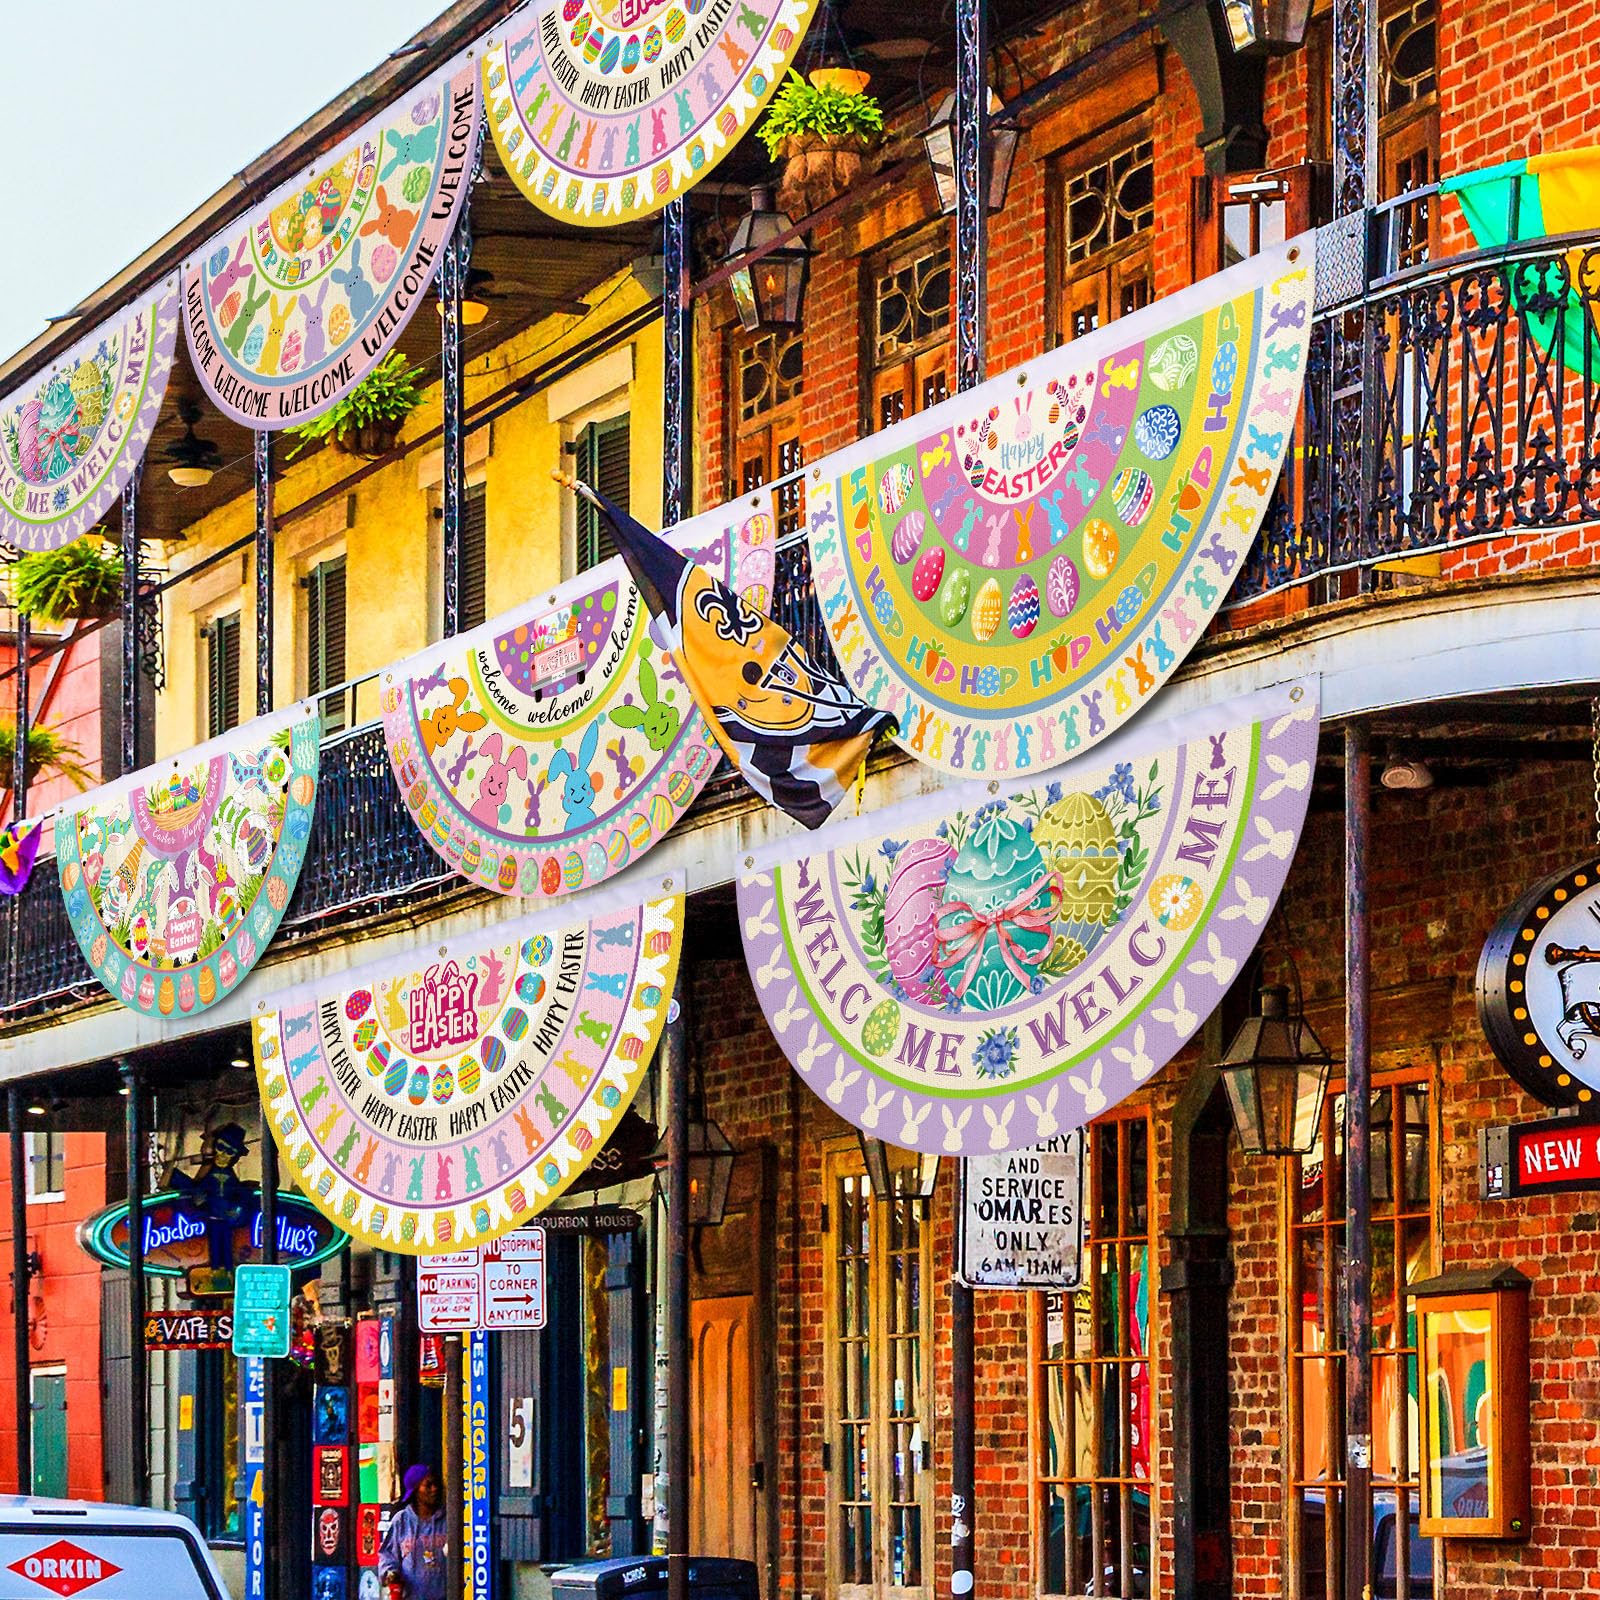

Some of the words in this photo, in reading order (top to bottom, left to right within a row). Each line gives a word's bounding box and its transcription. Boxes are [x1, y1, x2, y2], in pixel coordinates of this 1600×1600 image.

[541, 10, 554, 57] HAPPY
[551, 51, 580, 95] EASTER
[580, 79, 612, 110] HAPPY
[613, 76, 651, 110] EASTER
[660, 39, 696, 90] HAPPY
[186, 278, 217, 372] WELCOME
[214, 363, 272, 418] WELCOME
[279, 353, 356, 418] WELCOME
[361, 237, 437, 357] WELCOME
[432, 82, 475, 221] WELCOME
[1000, 431, 1045, 475] Happy
[981, 439, 1068, 498] EASTER
[477, 649, 519, 716] welcome
[527, 685, 595, 724] welcome
[603, 579, 638, 679] welcome
[170, 918, 196, 934] Happy
[169, 929, 198, 949] Easter!
[409, 971, 477, 1016] HAPPY
[321, 1000, 338, 1054] HAPPY
[332, 1047, 362, 1100] EASTER
[362, 1093, 398, 1132] HAPPY
[397, 1114, 438, 1141] EASTER
[449, 1099, 488, 1137] HAPPY
[492, 1059, 535, 1115] EASTER
[533, 996, 568, 1056] HAPPY
[557, 928, 585, 993] EASTER
[409, 1009, 478, 1053] EASTER
[1007, 1157, 1040, 1174] AND
[1524, 1138, 1581, 1174] NEW
[982, 1177, 1065, 1199] SERVICE
[533, 1215, 589, 1229] BOURBON
[595, 1214, 634, 1228] HOUSE
[500, 1238, 542, 1253] STOPPING
[996, 1231, 1049, 1252] ONLY
[506, 1264, 521, 1275] TO
[419, 1279, 438, 1292] NO
[439, 1276, 476, 1290] PARKING
[489, 1278, 538, 1291] CORNER
[488, 1308, 540, 1321] ANYTIME
[509, 1398, 525, 1449] 5
[472, 1401, 486, 1500] CIGARS
[24, 1557, 102, 1579] ORKIN
